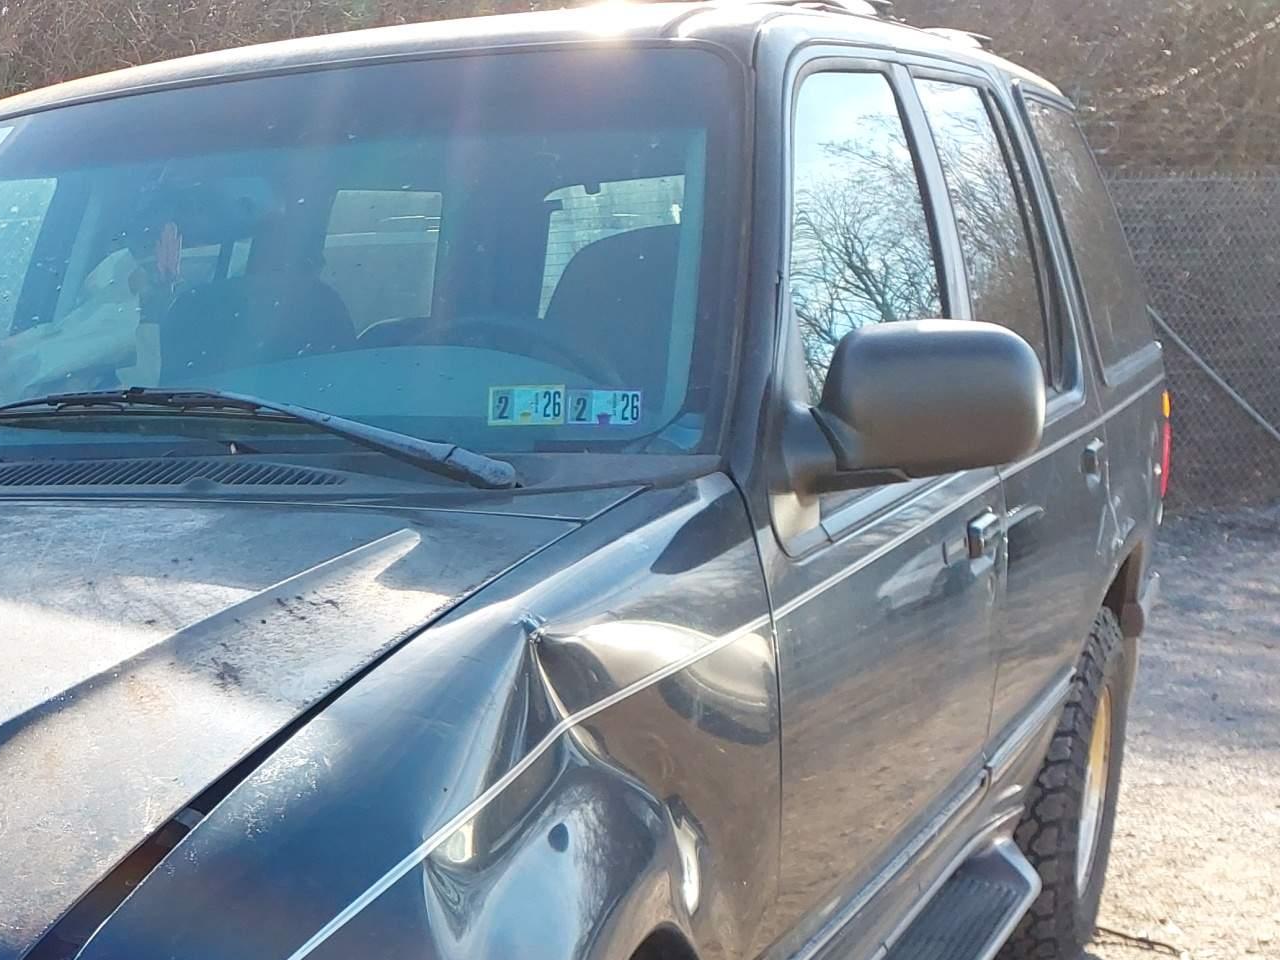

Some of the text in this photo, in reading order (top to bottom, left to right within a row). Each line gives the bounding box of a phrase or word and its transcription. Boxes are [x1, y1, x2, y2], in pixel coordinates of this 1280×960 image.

[497, 396, 509, 419] 2
[543, 391, 561, 418] 26
[575, 398, 587, 421] 2
[621, 393, 640, 421] 26
